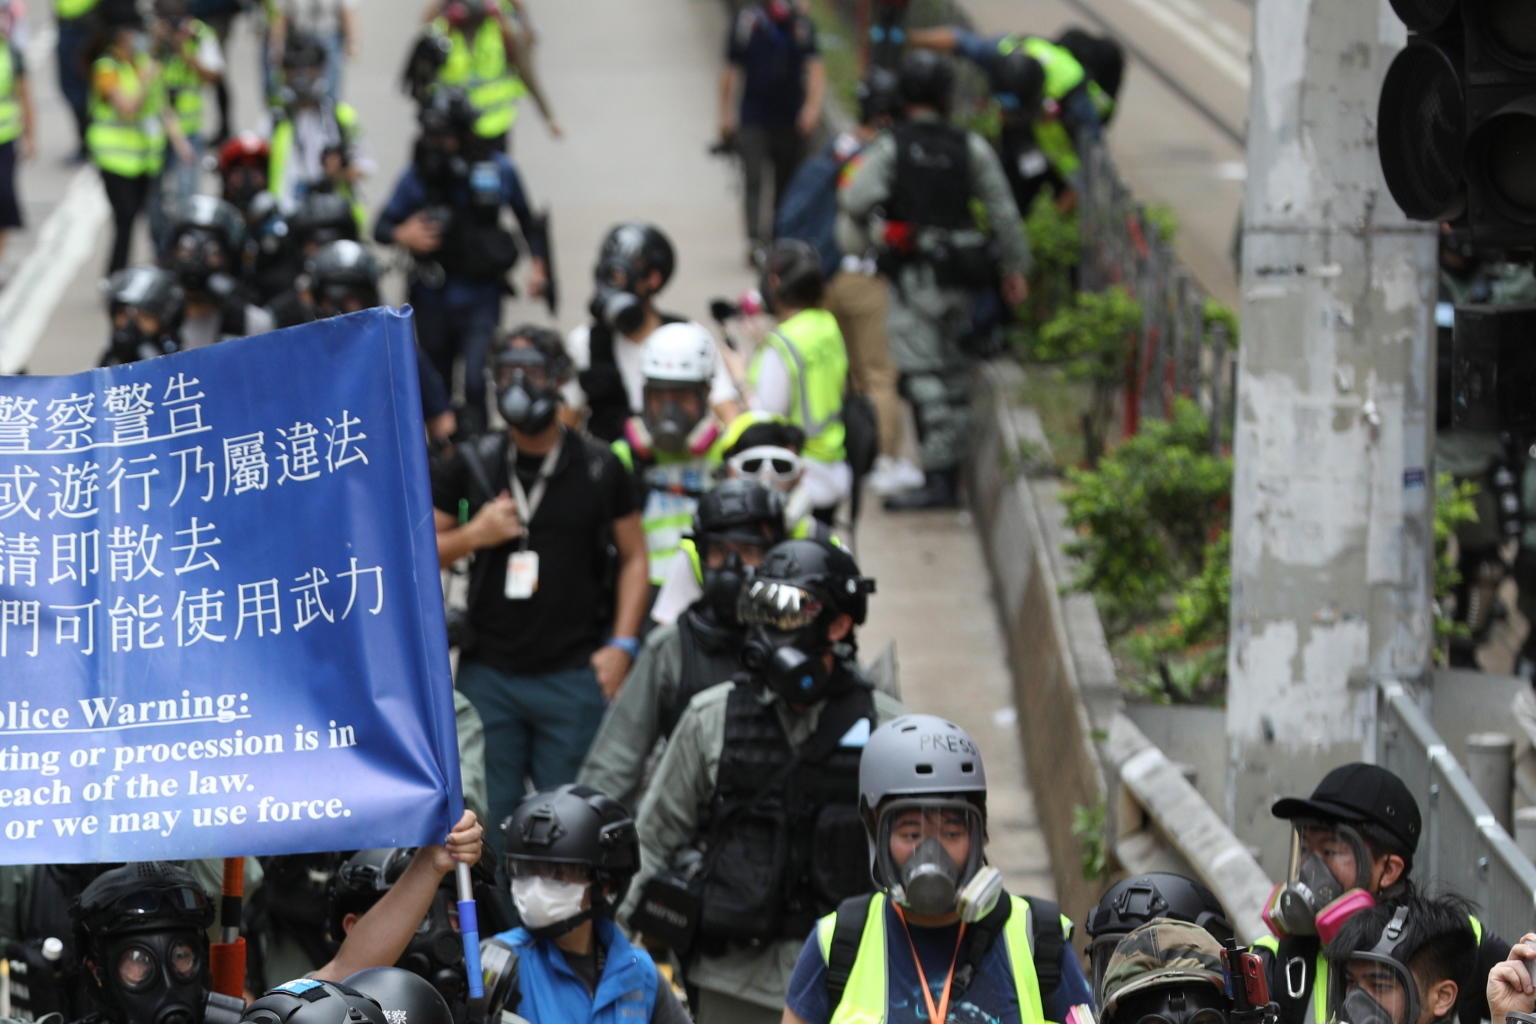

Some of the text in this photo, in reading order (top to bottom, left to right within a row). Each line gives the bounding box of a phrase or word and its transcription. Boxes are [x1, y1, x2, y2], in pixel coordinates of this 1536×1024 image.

[79, 690, 251, 724] Warning:
[69, 747, 106, 769] or
[112, 730, 284, 773] procession
[294, 730, 319, 752] is
[328, 720, 355, 749] in
[920, 733, 977, 757] PRESS
[82, 774, 121, 802] of
[125, 772, 180, 800] the
[187, 768, 255, 797] law.
[5, 819, 45, 841] or
[51, 815, 99, 838] we
[108, 809, 183, 839] may
[191, 802, 248, 828] use
[256, 793, 353, 826] force.
